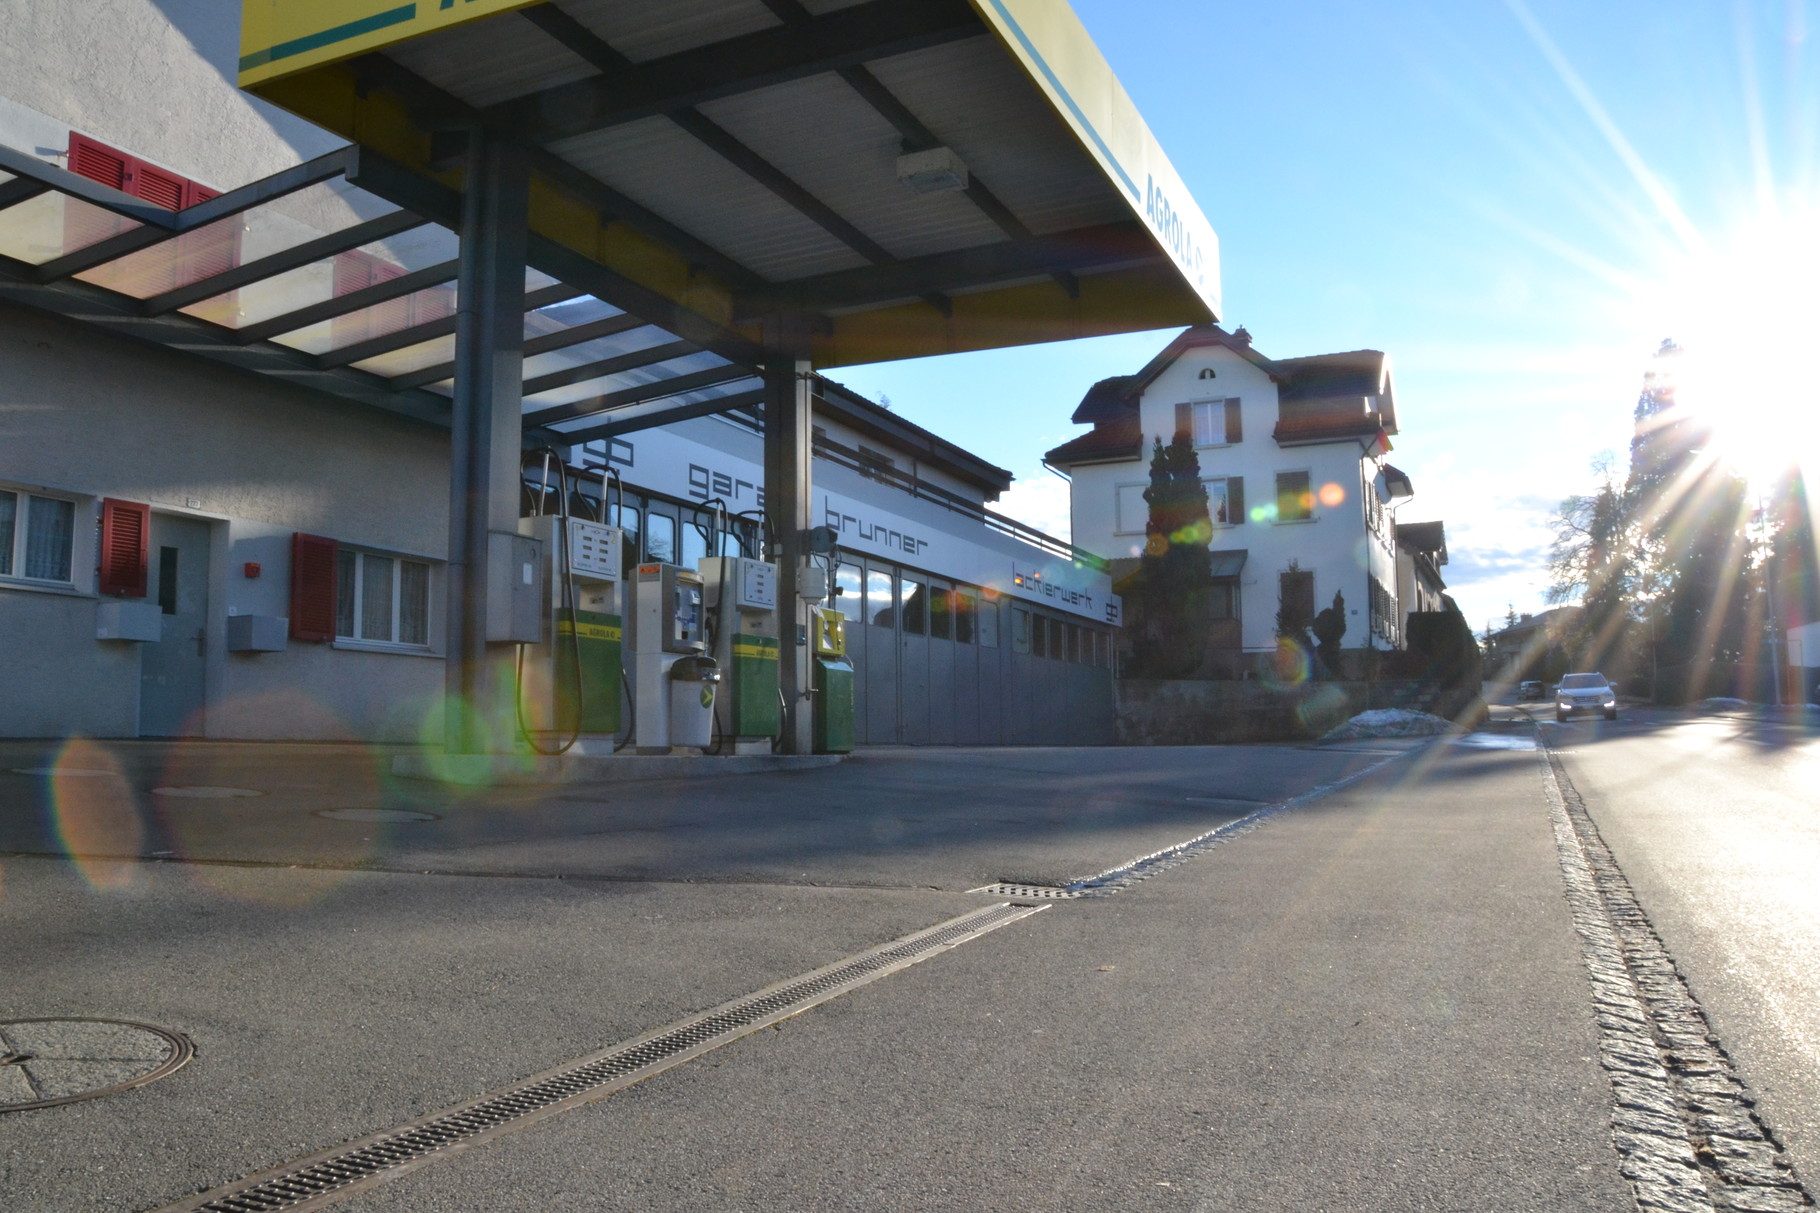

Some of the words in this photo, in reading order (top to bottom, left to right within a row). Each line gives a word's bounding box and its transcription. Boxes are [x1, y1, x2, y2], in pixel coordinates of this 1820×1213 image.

[1146, 172, 1193, 273] AGROLA
[825, 495, 929, 556] brunner
[1012, 561, 1093, 609] lackierwerk
